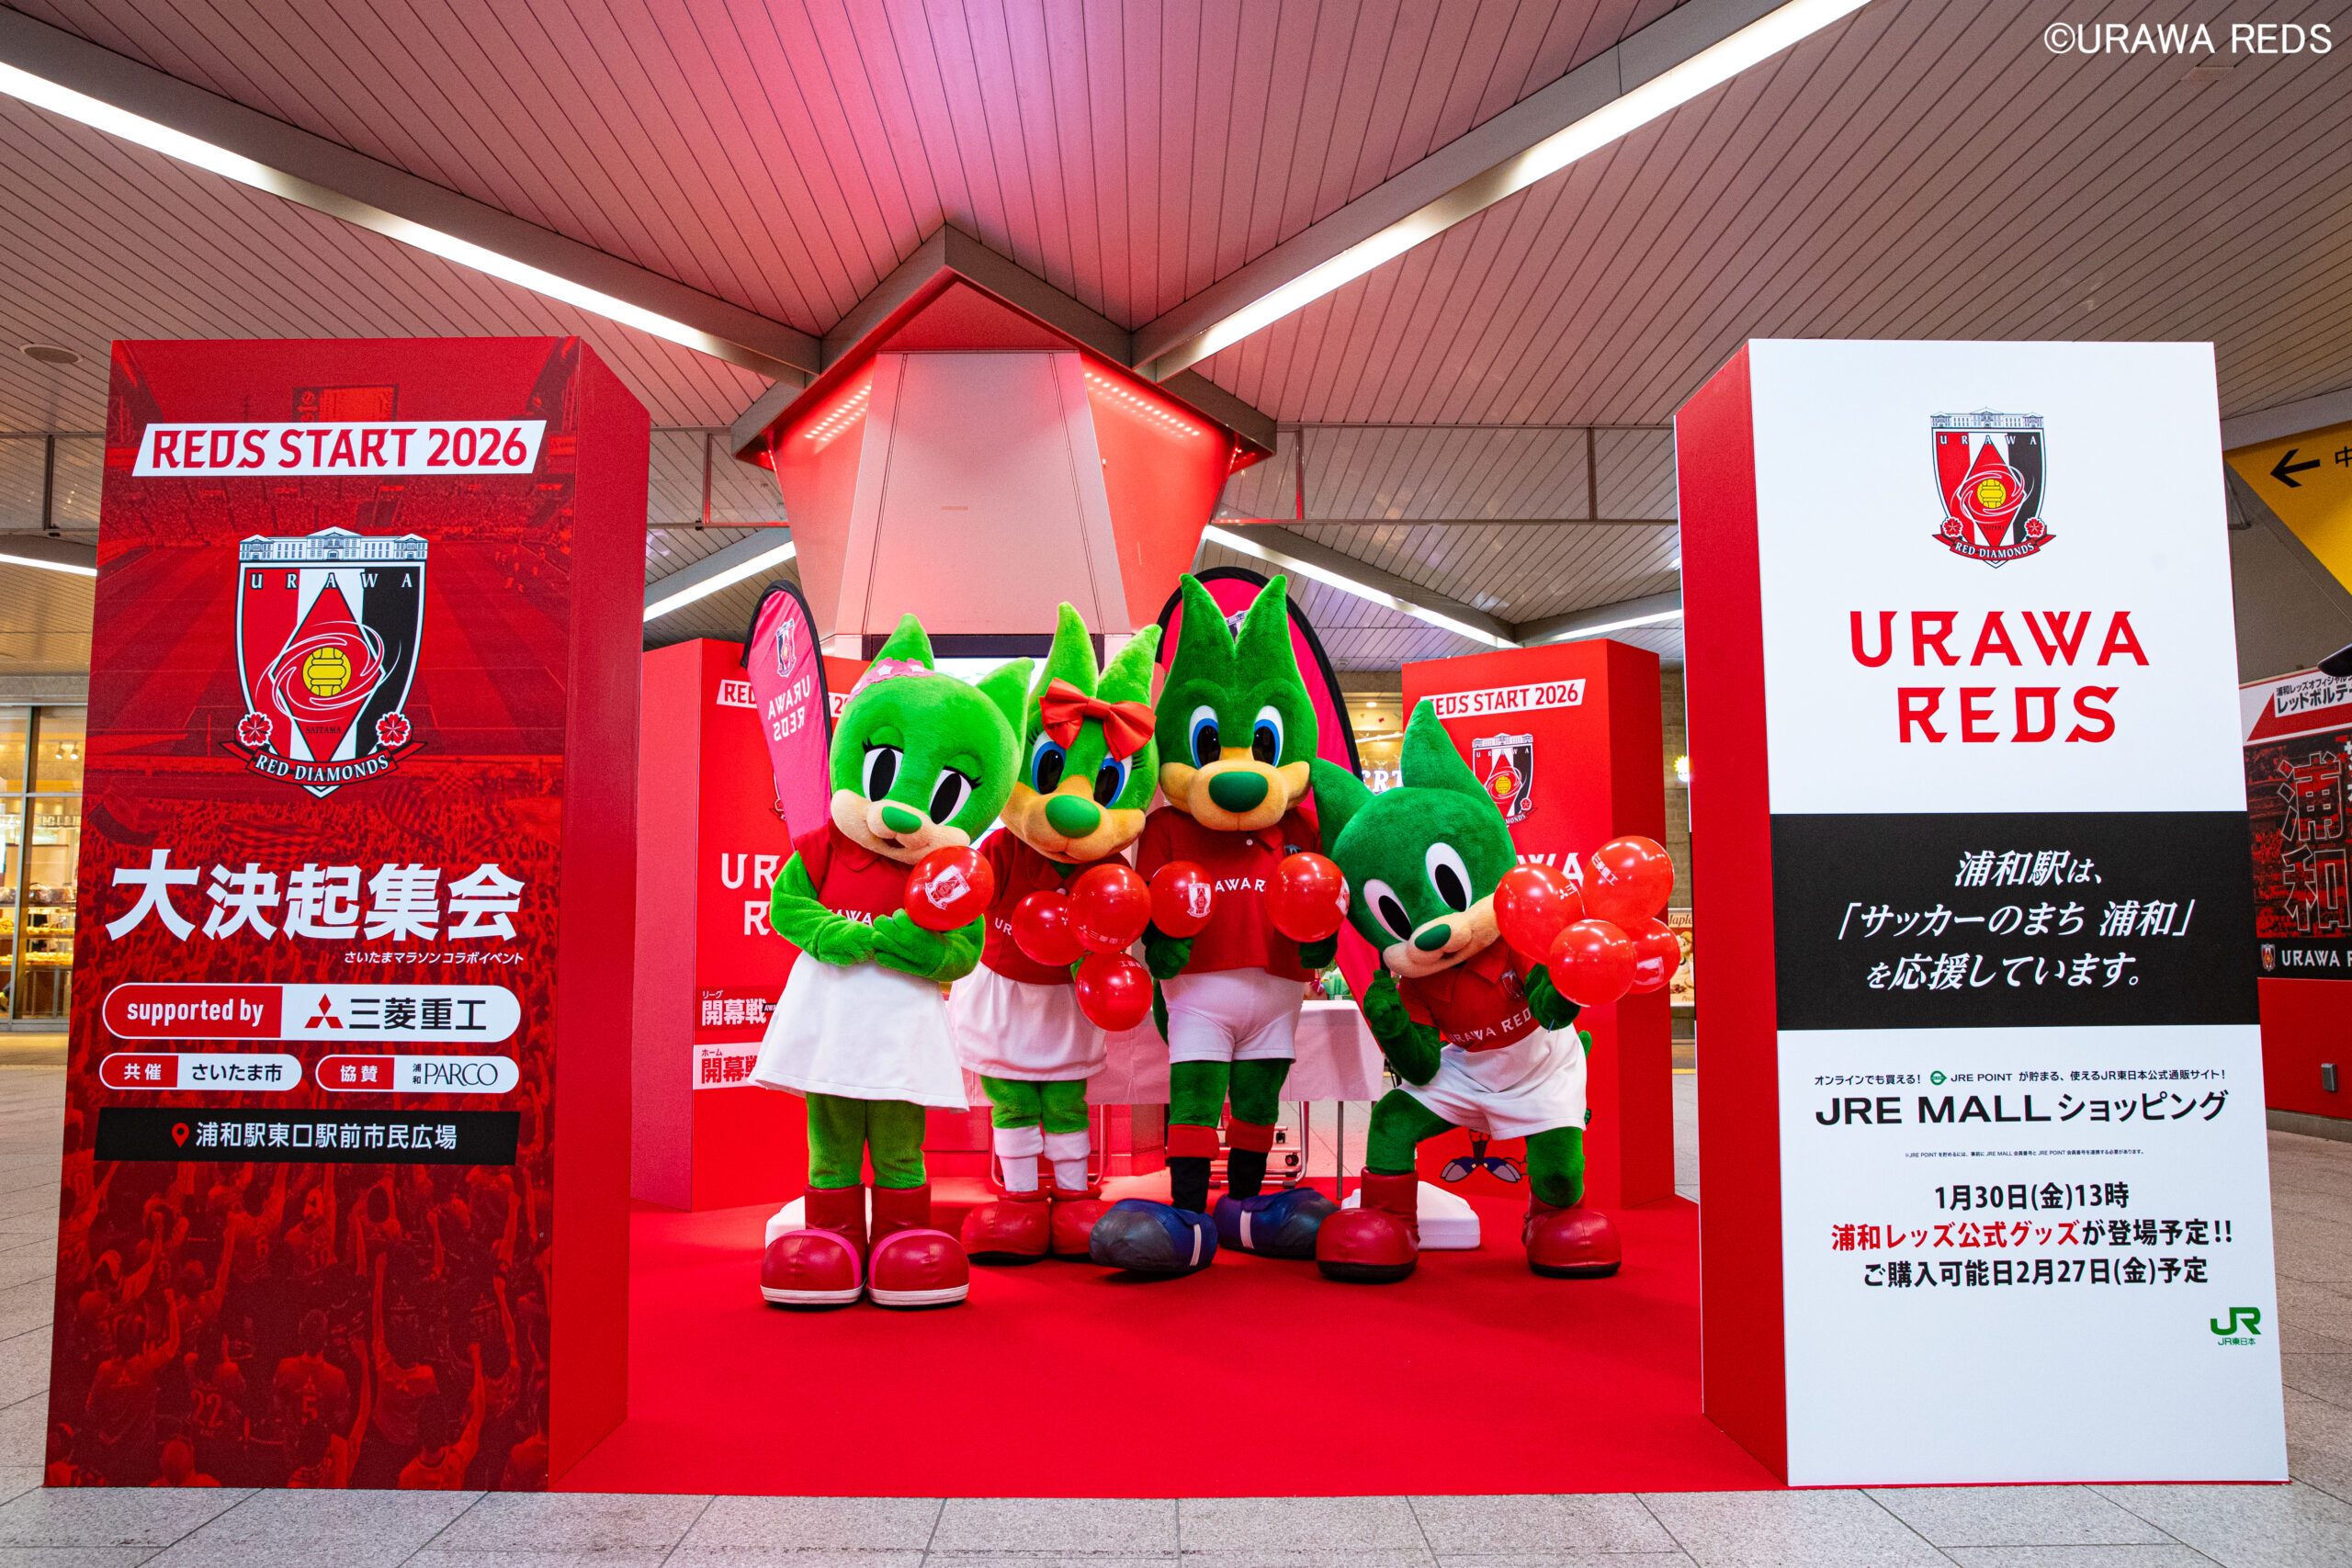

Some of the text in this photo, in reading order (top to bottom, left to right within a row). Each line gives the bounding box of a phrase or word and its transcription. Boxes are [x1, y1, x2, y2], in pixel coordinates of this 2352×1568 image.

[153, 427, 527, 468] REDS START 2026
[1955, 542, 2035, 558] RED DIAMONDS
[251, 572, 413, 589] URAWA
[1849, 610, 2150, 668] URAWA
[1430, 682, 1578, 716] EDS START 2026
[2278, 683, 2352, 714] レッドボルテ
[1897, 685, 2120, 743] REDS
[305, 726, 342, 734] SAITAMA
[254, 754, 390, 782] RED DIAMONDS
[1954, 850, 2102, 887] 浦和駅は、
[104, 848, 526, 942] 大決起集会
[1866, 952, 2139, 991] を応援しています。
[2281, 950, 2341, 967] URAWA
[702, 989, 724, 999] リーグ
[127, 998, 265, 1027] supported by
[349, 998, 487, 1031] 三菱重工
[701, 998, 767, 1027] 開幕戦
[1500, 1007, 1532, 1033] RED
[701, 1048, 723, 1057] ホーム
[124, 1063, 162, 1081] 共催
[192, 1063, 283, 1083] さいたま市
[340, 1065, 379, 1083] 協賛
[424, 1063, 498, 1086] PARCO
[1951, 1073, 1973, 1082] JRE
[1977, 1073, 2013, 1082] POINT
[1815, 1096, 1903, 1126] JRE
[196, 1122, 458, 1150] 浦和駅東口駅前市民広場
[1935, 1181, 2130, 1212] 1月30日(金)13時
[1864, 1256, 2209, 1288] ご購入可能日2月27日(金)予定
[2210, 1306, 2262, 1336] JR
[2217, 1337, 2256, 1346] JR東日本
